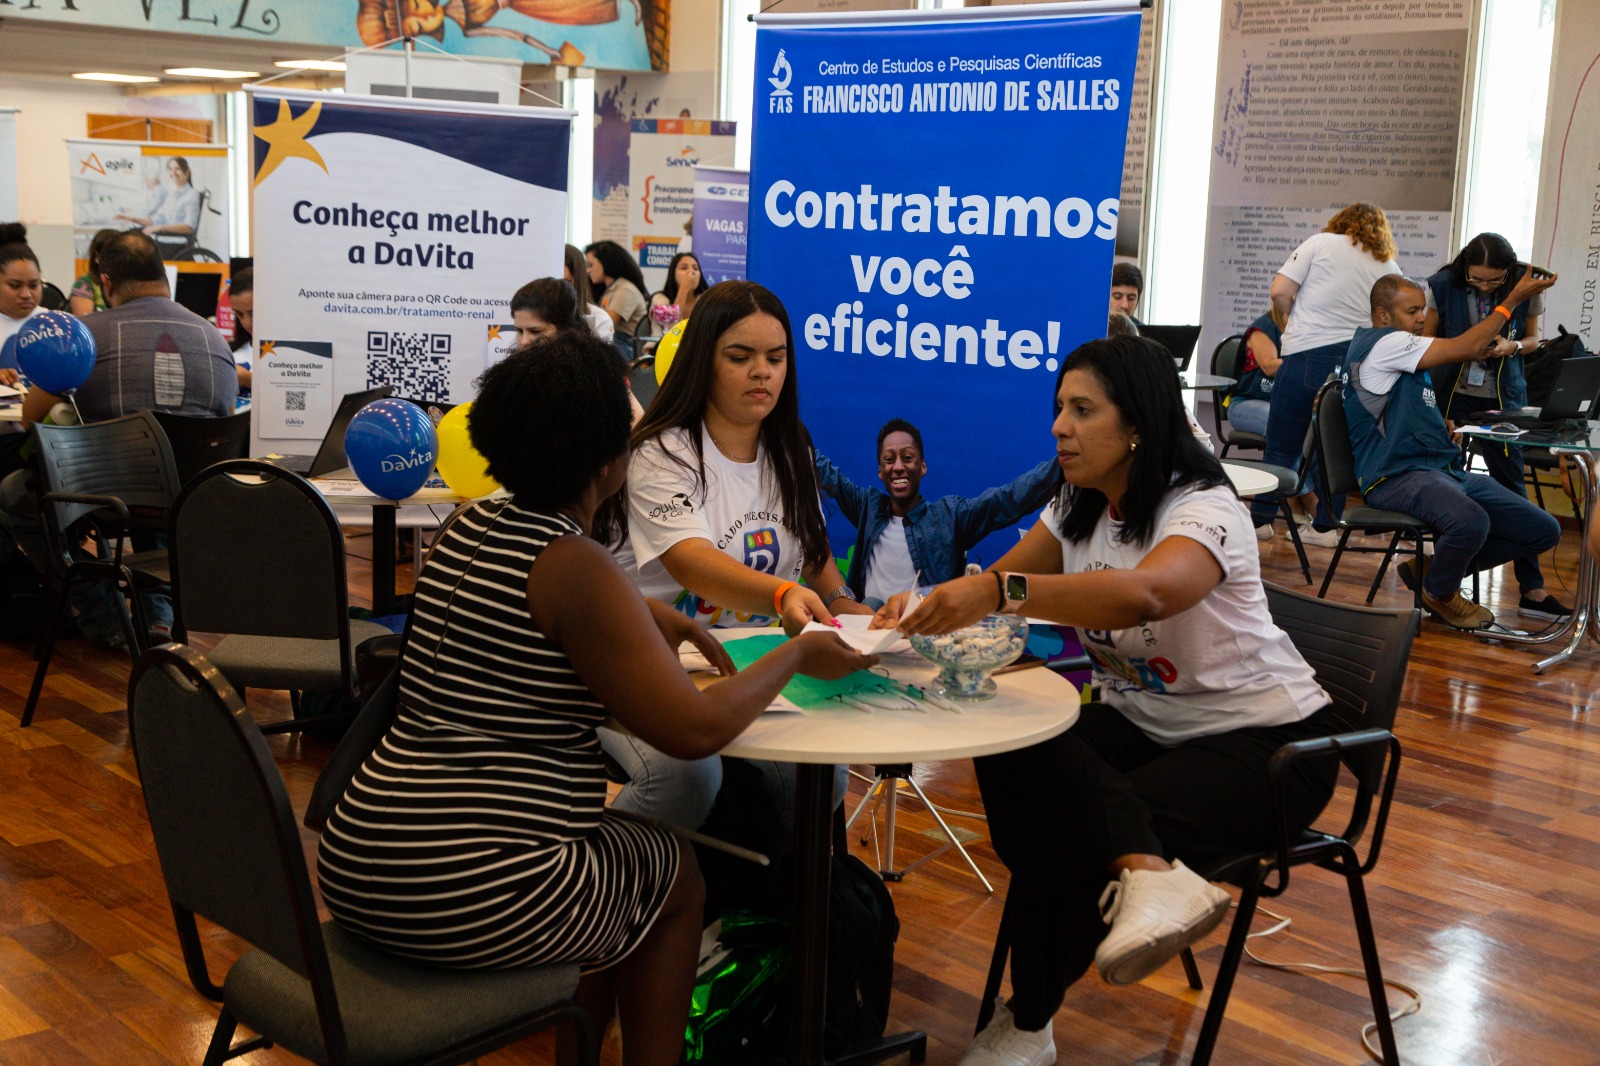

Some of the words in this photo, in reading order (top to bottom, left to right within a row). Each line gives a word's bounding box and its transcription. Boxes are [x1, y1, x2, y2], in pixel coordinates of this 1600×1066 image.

[818, 60, 859, 76] Centro
[862, 58, 878, 74] de
[882, 57, 934, 73] Estudos
[938, 61, 946, 71] e
[950, 55, 1020, 75] Pesquisas
[1024, 53, 1102, 70] Científicas
[1280, 62, 1307, 70] vivendo
[1334, 60, 1360, 69] história
[803, 84, 904, 113] FRANCISCO
[909, 81, 997, 112] ANTONIO
[1004, 80, 1029, 111] DE
[1036, 78, 1120, 112] SALLES
[1324, 84, 1338, 92] feliz
[1350, 84, 1365, 92] lado
[1403, 84, 1431, 92] Geraldo
[769, 97, 793, 113] FAS
[1362, 97, 1388, 105] Acabou
[1283, 108, 1320, 116] abandonou
[1269, 153, 1292, 162] menina
[1307, 154, 1324, 163] onde
[1340, 155, 1367, 165] homem
[1369, 156, 1387, 166] pode
[1390, 158, 1408, 166] amar
[293, 200, 418, 237] Conheça
[428, 209, 530, 236] melhor
[764, 180, 1120, 241] Contratamos
[705, 218, 744, 234] VAGAS
[348, 244, 365, 264] a
[374, 241, 474, 270] DaVita
[1586, 245, 1600, 270] EM
[850, 245, 975, 299] você
[298, 288, 336, 302] Aponte
[337, 291, 354, 299] sua
[356, 290, 392, 302] câmera
[393, 295, 416, 304] para
[425, 294, 441, 305] QR
[443, 295, 468, 305] Code
[323, 303, 495, 320] davita.com.br/tratamento-renal
[1580, 279, 1597, 338] AUTOR
[19, 325, 64, 348] DaVita
[804, 300, 1061, 372] eficiente!
[268, 361, 297, 370] Conheça
[299, 362, 323, 370] melhor
[287, 370, 311, 378] DaVita
[380, 447, 433, 473] DaVita
